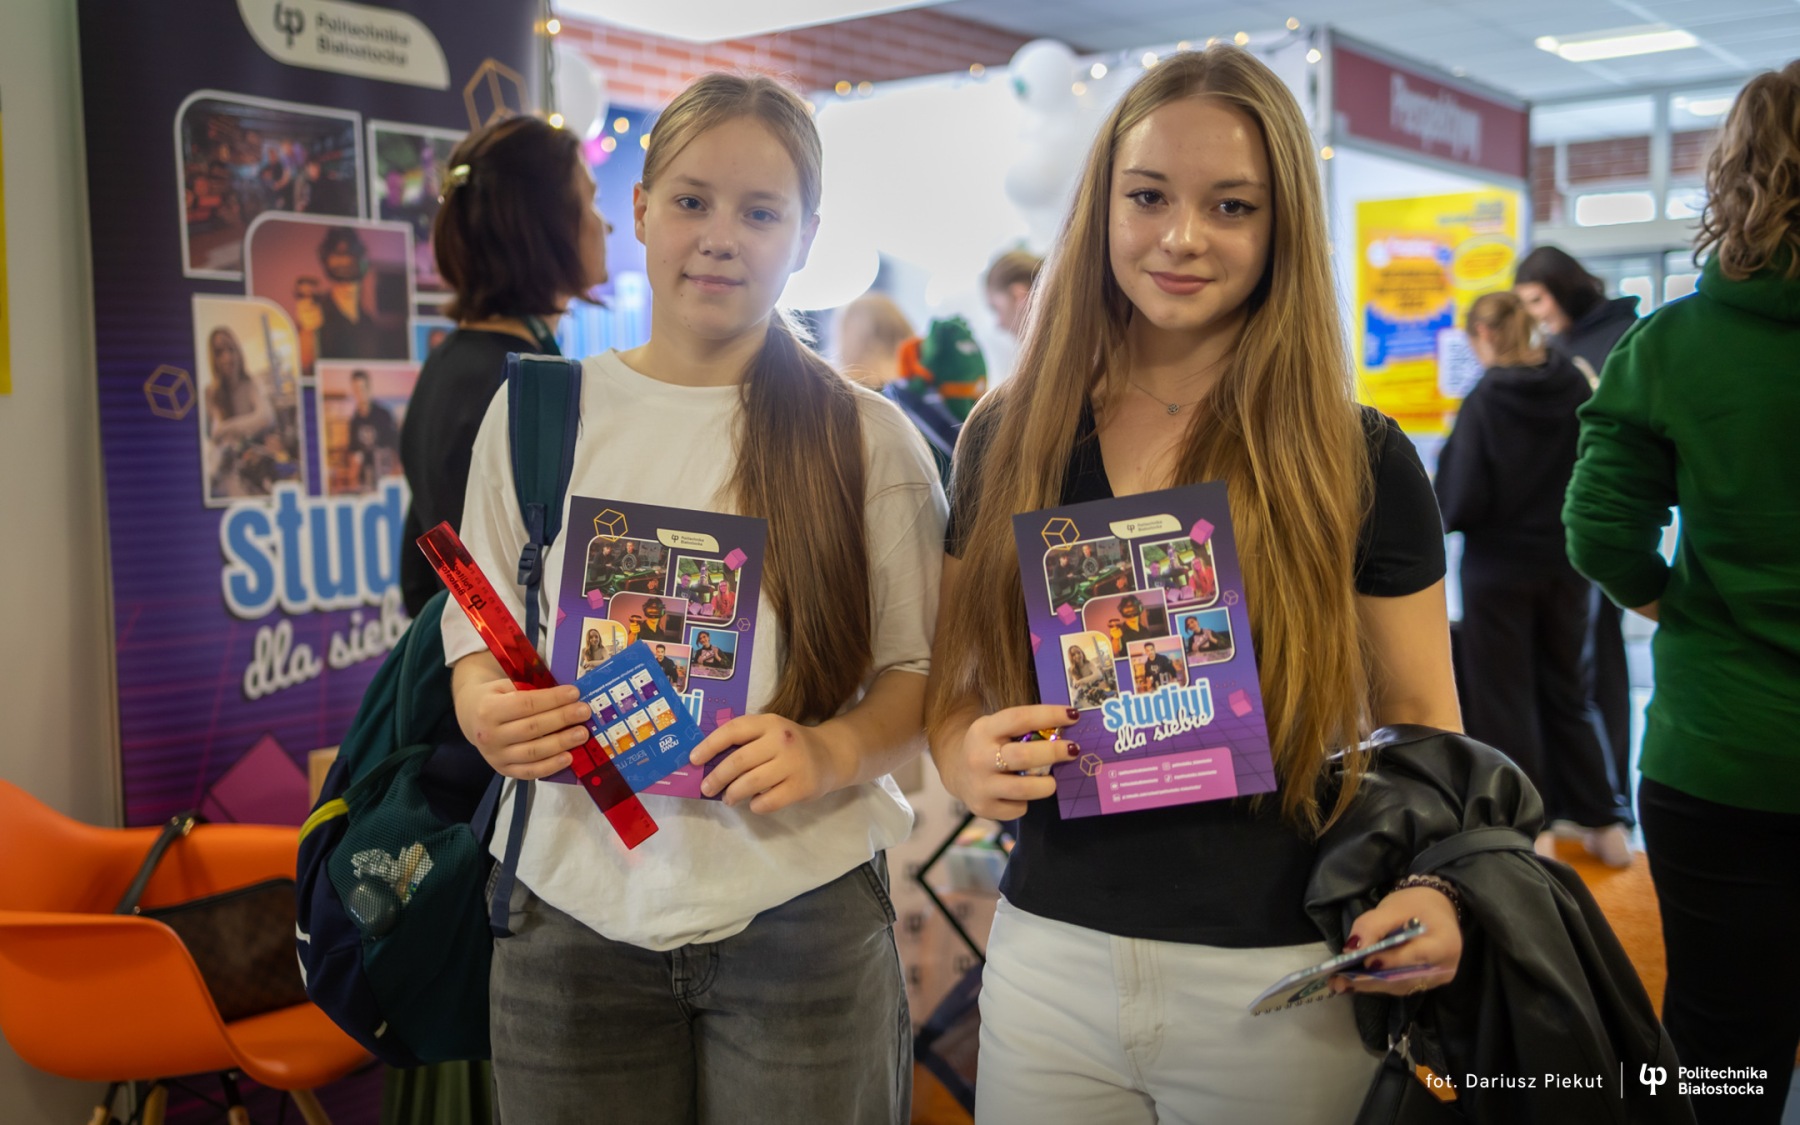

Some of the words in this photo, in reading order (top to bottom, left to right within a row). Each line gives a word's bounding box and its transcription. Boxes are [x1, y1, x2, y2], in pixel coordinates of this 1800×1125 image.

[223, 481, 408, 613] stud
[243, 618, 324, 700] dla
[328, 584, 414, 669] sieb
[1103, 680, 1213, 730] studiuj
[1114, 724, 1147, 753] dla
